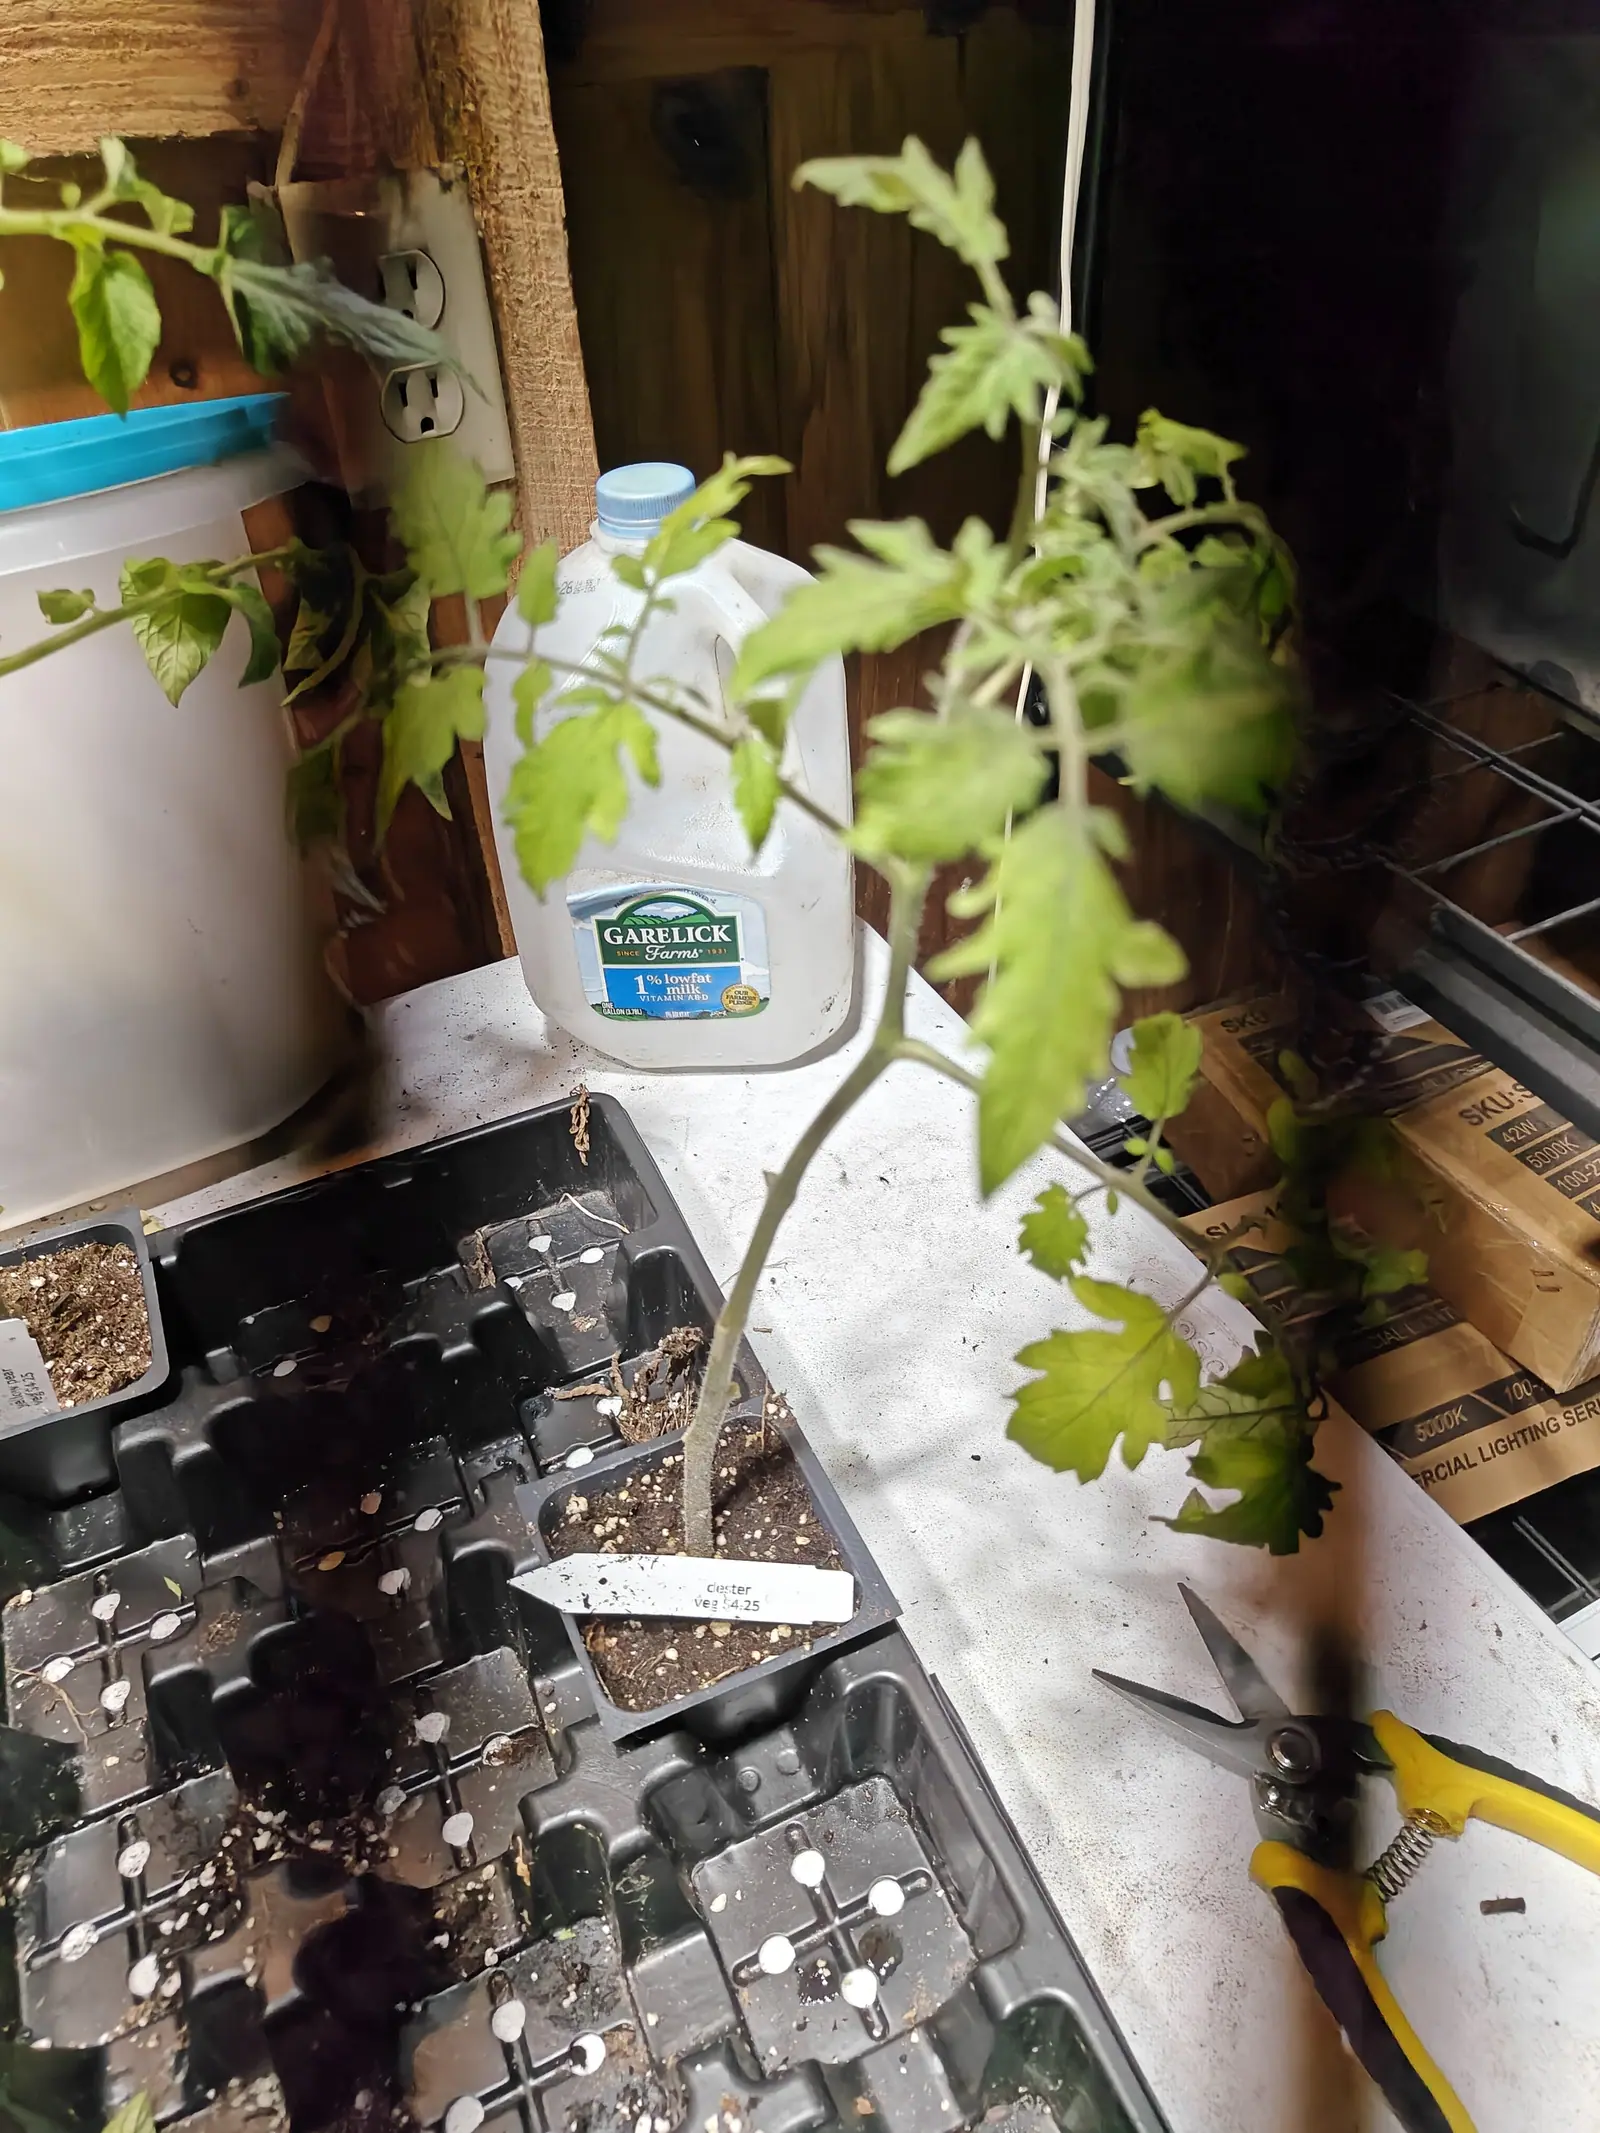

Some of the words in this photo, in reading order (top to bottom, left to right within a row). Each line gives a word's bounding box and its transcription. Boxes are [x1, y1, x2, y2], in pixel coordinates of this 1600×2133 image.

[603, 924, 732, 945] GARELICK
[634, 974, 662, 995] 1%
[664, 972, 712, 985] lowfat
[666, 983, 701, 995] milk
[640, 994, 684, 1002] VITAMIN
[1501, 1118, 1538, 1144] 42W
[1526, 1133, 1580, 1168] 5000K
[1415, 1404, 1469, 1443] 5000K
[1478, 1418, 1561, 1463] LIGHTING
[694, 1598, 718, 1612] veg
